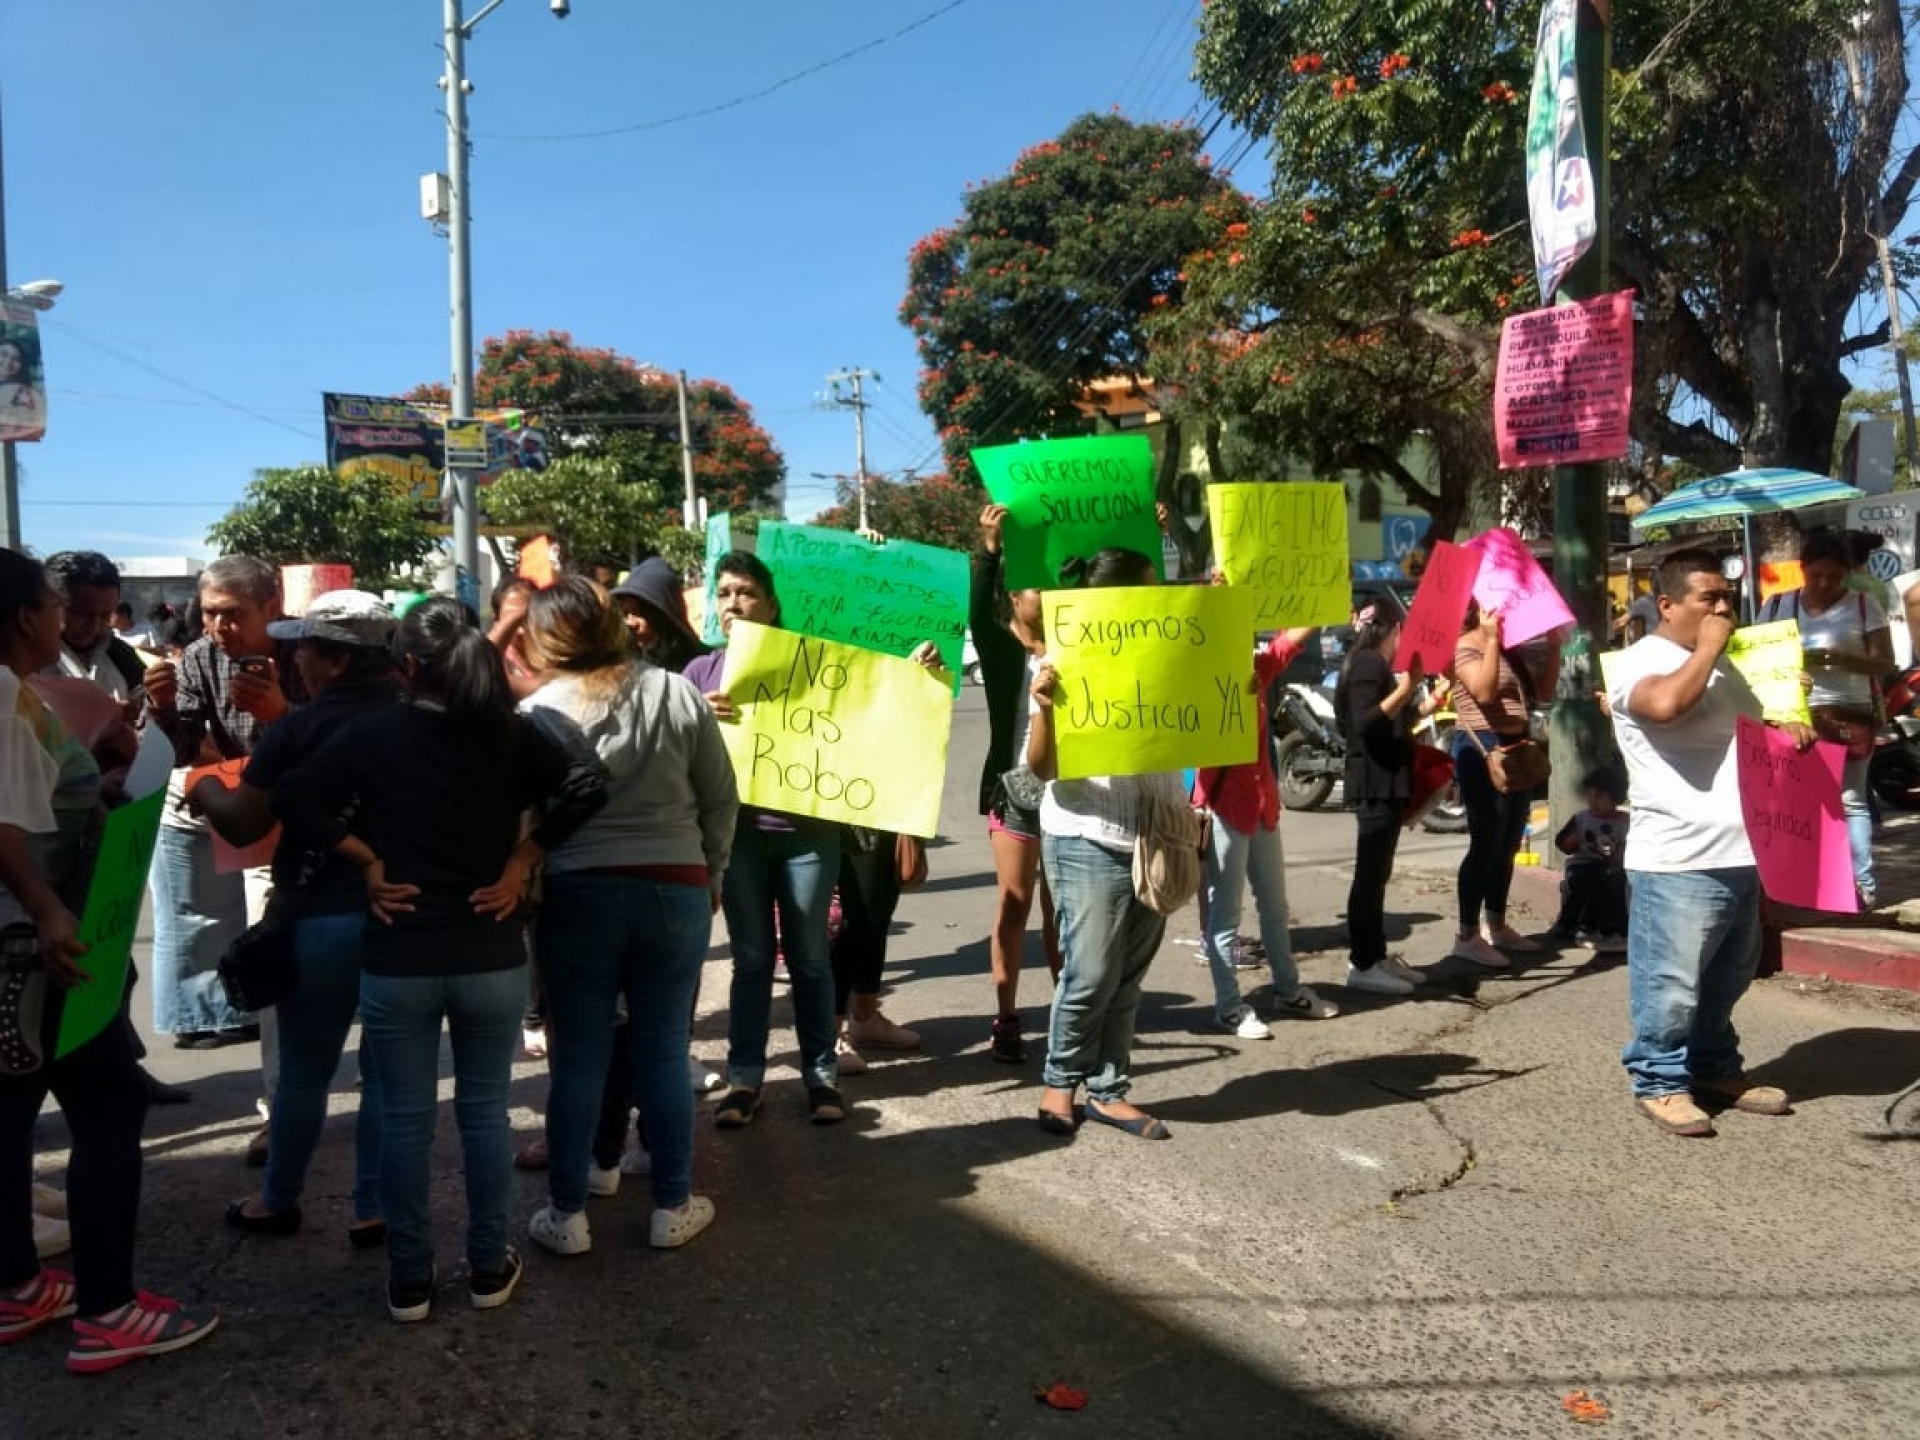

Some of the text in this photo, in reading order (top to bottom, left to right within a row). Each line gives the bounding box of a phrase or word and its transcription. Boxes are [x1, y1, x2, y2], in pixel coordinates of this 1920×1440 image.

[1009, 458, 1134, 485] QUEREMOS
[1039, 490, 1142, 526] SOLUCION
[1054, 604, 1206, 656] Exigimos
[784, 636, 847, 691] No
[753, 681, 842, 743] Mas
[1071, 673, 1244, 737] Justicia YA
[752, 732, 875, 811] Robo
